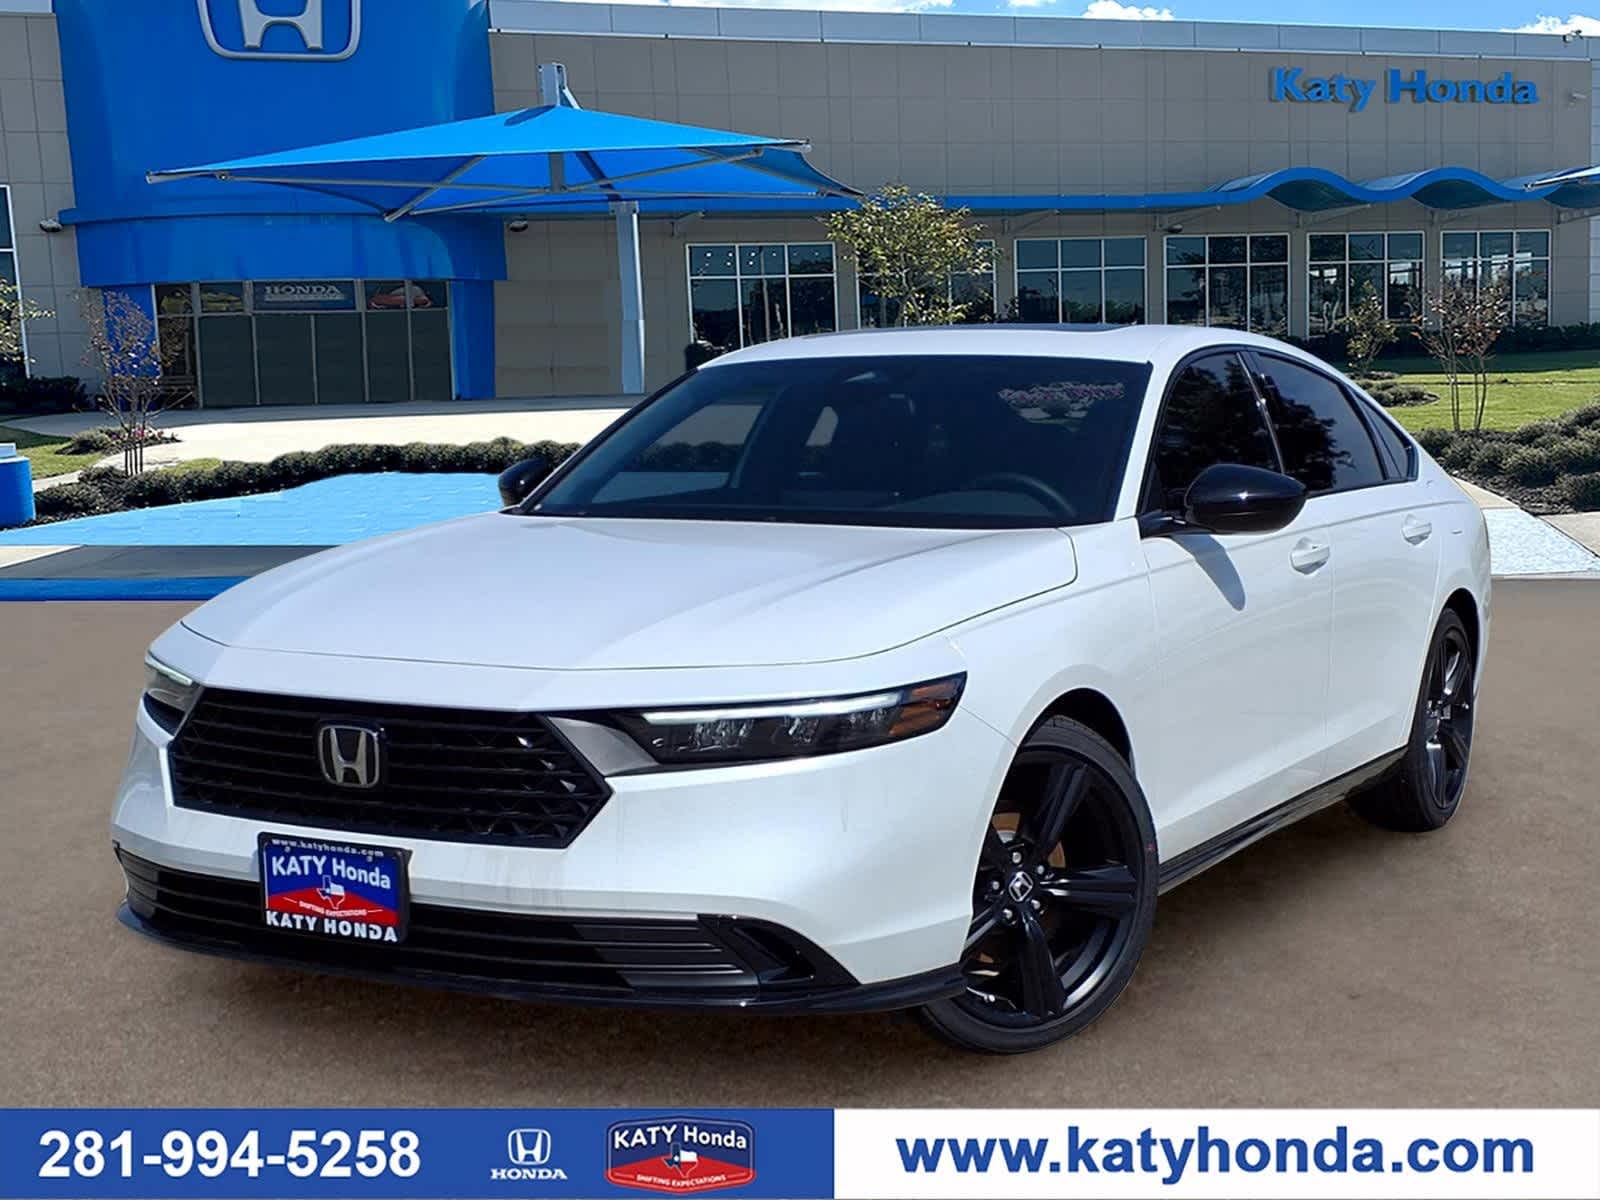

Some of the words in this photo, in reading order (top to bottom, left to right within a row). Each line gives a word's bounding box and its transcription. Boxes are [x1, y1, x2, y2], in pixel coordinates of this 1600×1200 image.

[1272, 67, 1376, 112] Katy
[1387, 69, 1540, 105] Honda
[265, 285, 342, 296] HONDA
[272, 839, 384, 857] www.katyhonda.com
[272, 855, 326, 876] KATY
[332, 858, 391, 889] Honda
[266, 911, 318, 931] KATY
[324, 918, 397, 942] HONDA
